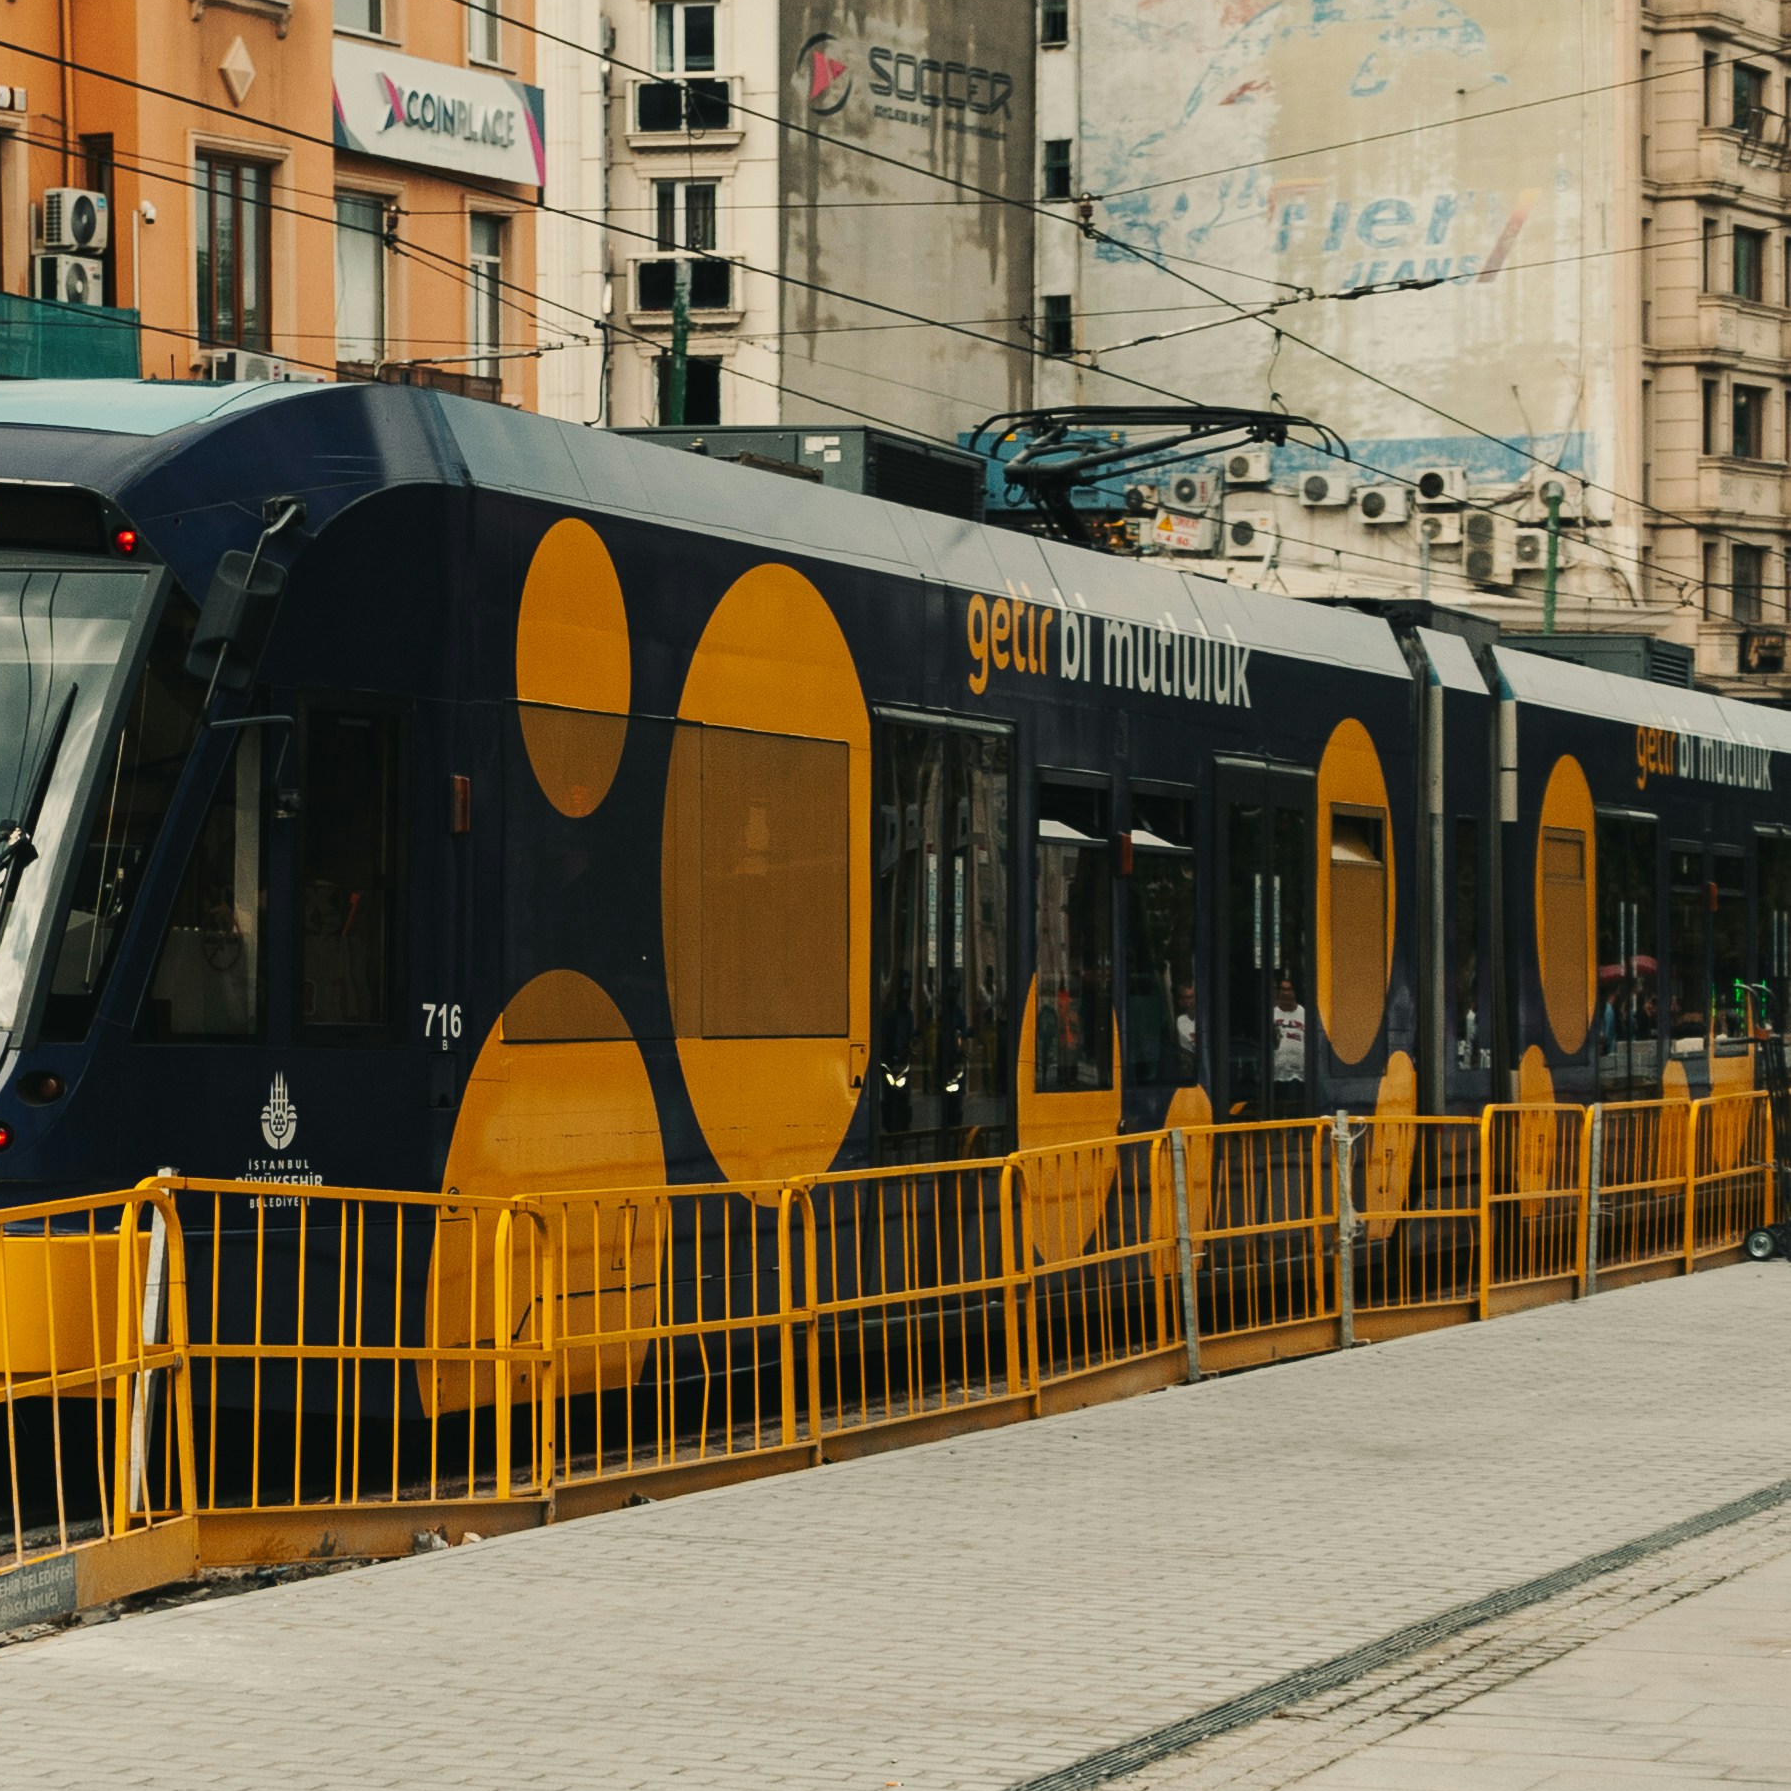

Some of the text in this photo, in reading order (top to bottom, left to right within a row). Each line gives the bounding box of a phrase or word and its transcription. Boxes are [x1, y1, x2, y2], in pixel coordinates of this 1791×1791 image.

[868, 46, 1013, 121] SOCCER
[967, 577, 1053, 695] getir
[1103, 611, 1252, 708] mutluluk
[1636, 711, 1677, 791] getir
[1698, 727, 1773, 792] mutluluk
[422, 1003, 462, 1038] 716
[442, 1039, 448, 1051] B
[248, 1158, 309, 1171] İSTANBUL
